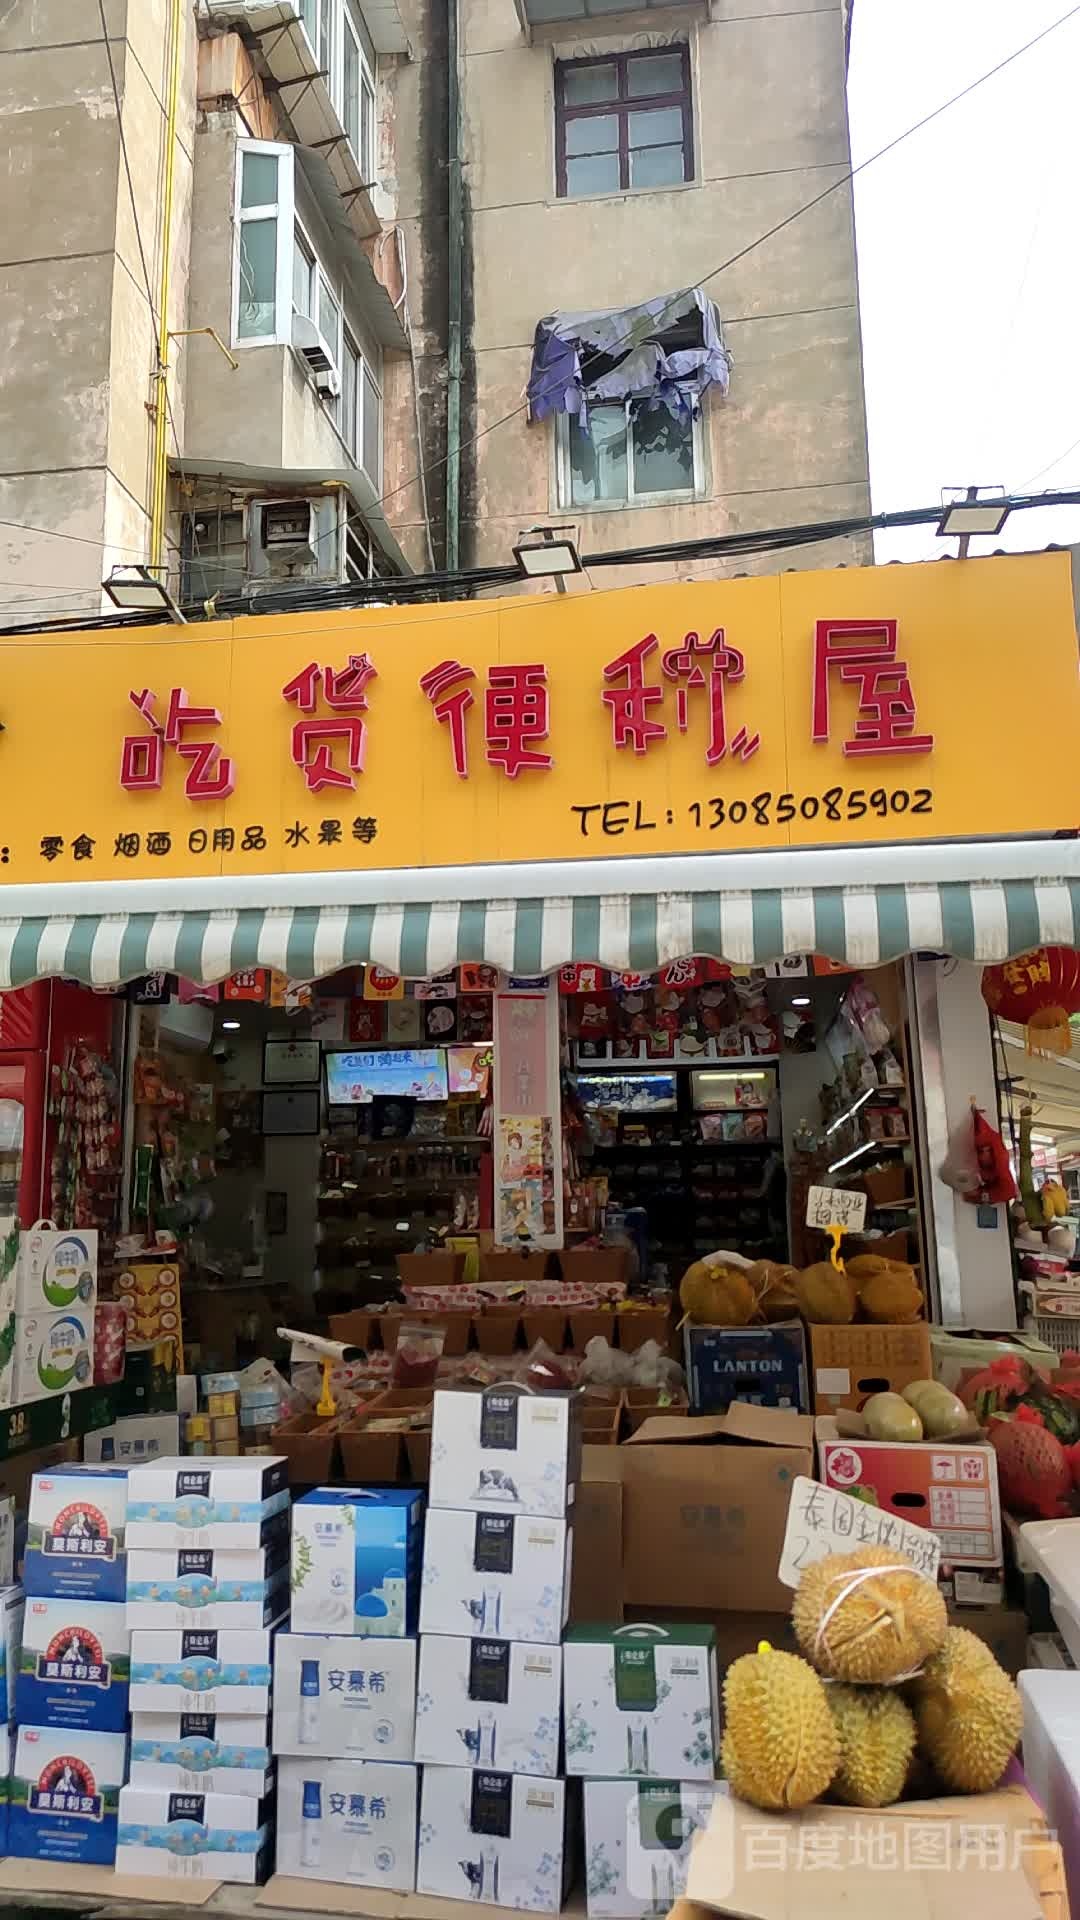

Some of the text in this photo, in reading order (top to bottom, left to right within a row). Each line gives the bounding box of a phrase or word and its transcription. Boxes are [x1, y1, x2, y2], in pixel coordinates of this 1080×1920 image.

[40, 816, 378, 862] 零食 烟酒 日用品 水果等
[713, 1359, 783, 1373] LANTON
[327, 1668, 386, 1694] 安慕希
[328, 1792, 387, 1820] 安慕希
